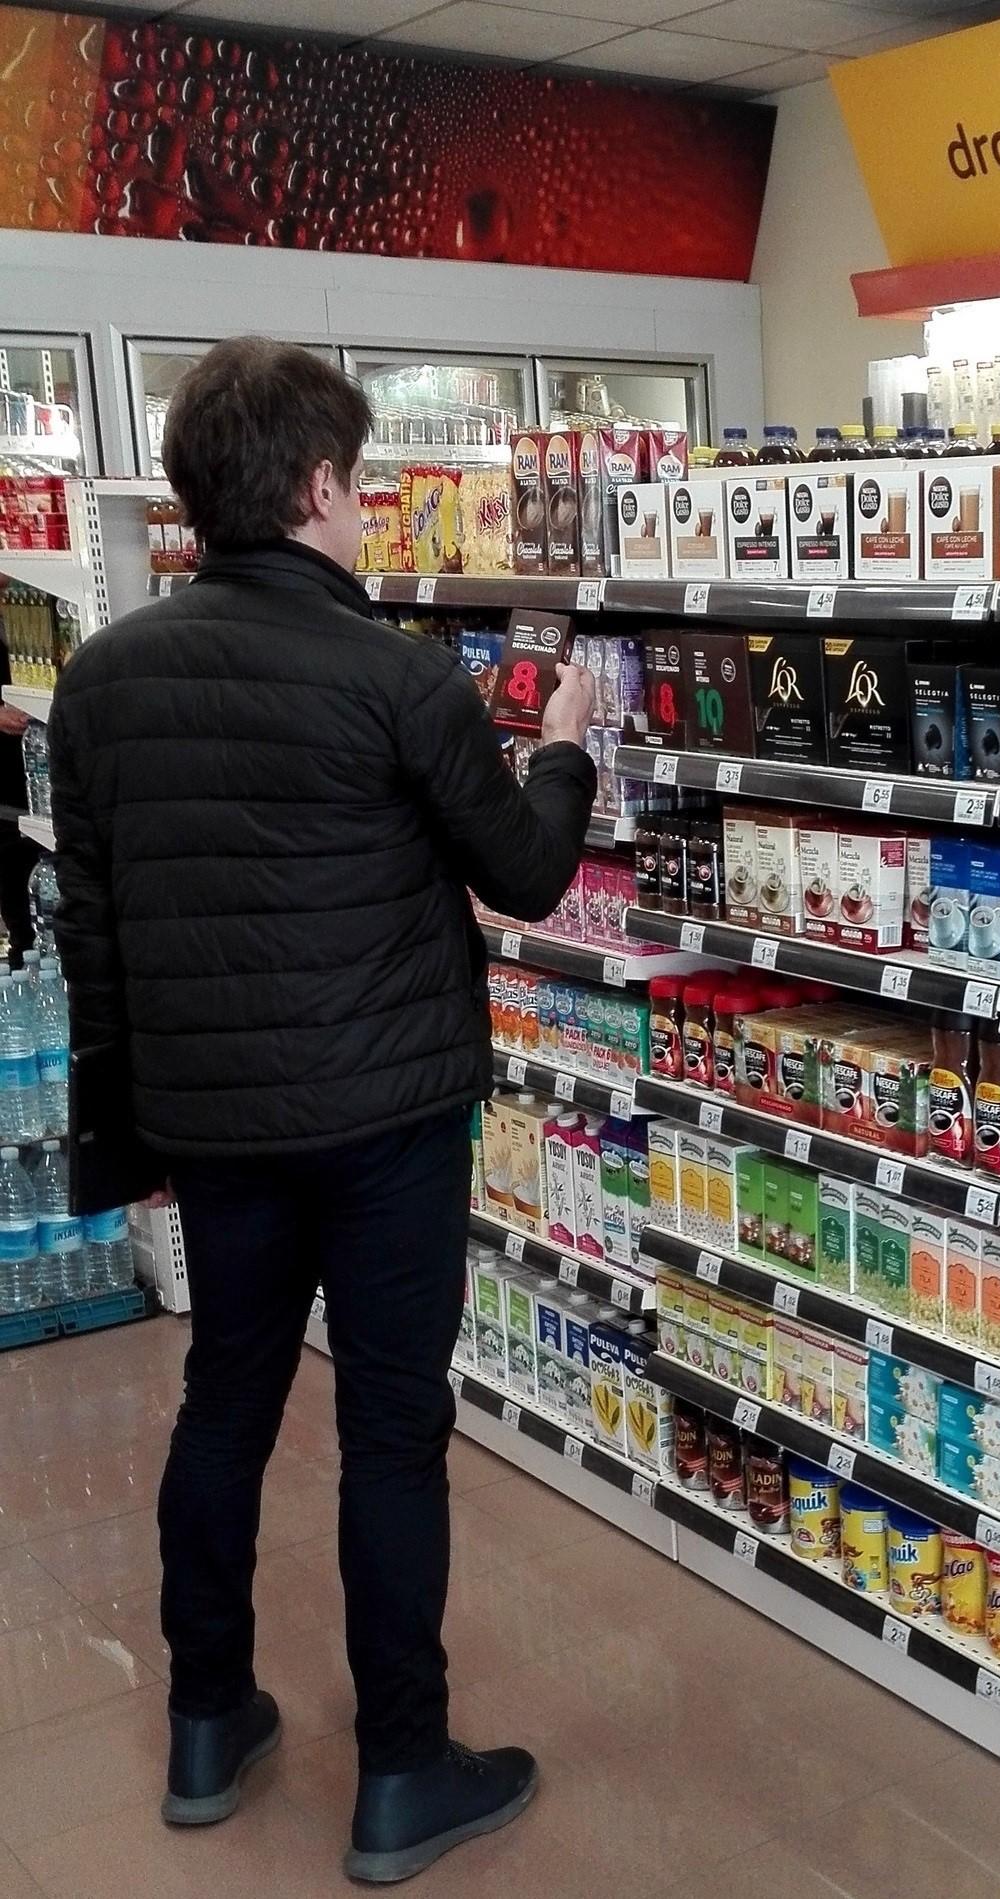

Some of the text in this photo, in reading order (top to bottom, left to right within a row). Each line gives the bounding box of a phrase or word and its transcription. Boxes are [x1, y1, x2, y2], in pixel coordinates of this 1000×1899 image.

[518, 454, 537, 469] RAM
[550, 454, 569, 469] RAM
[611, 463, 632, 472] RAM
[661, 464, 680, 473] RAM
[462, 646, 490, 661] PULEVA
[512, 642, 557, 654] DESCAFEINADO
[590, 1334, 620, 1356] PULEVA
